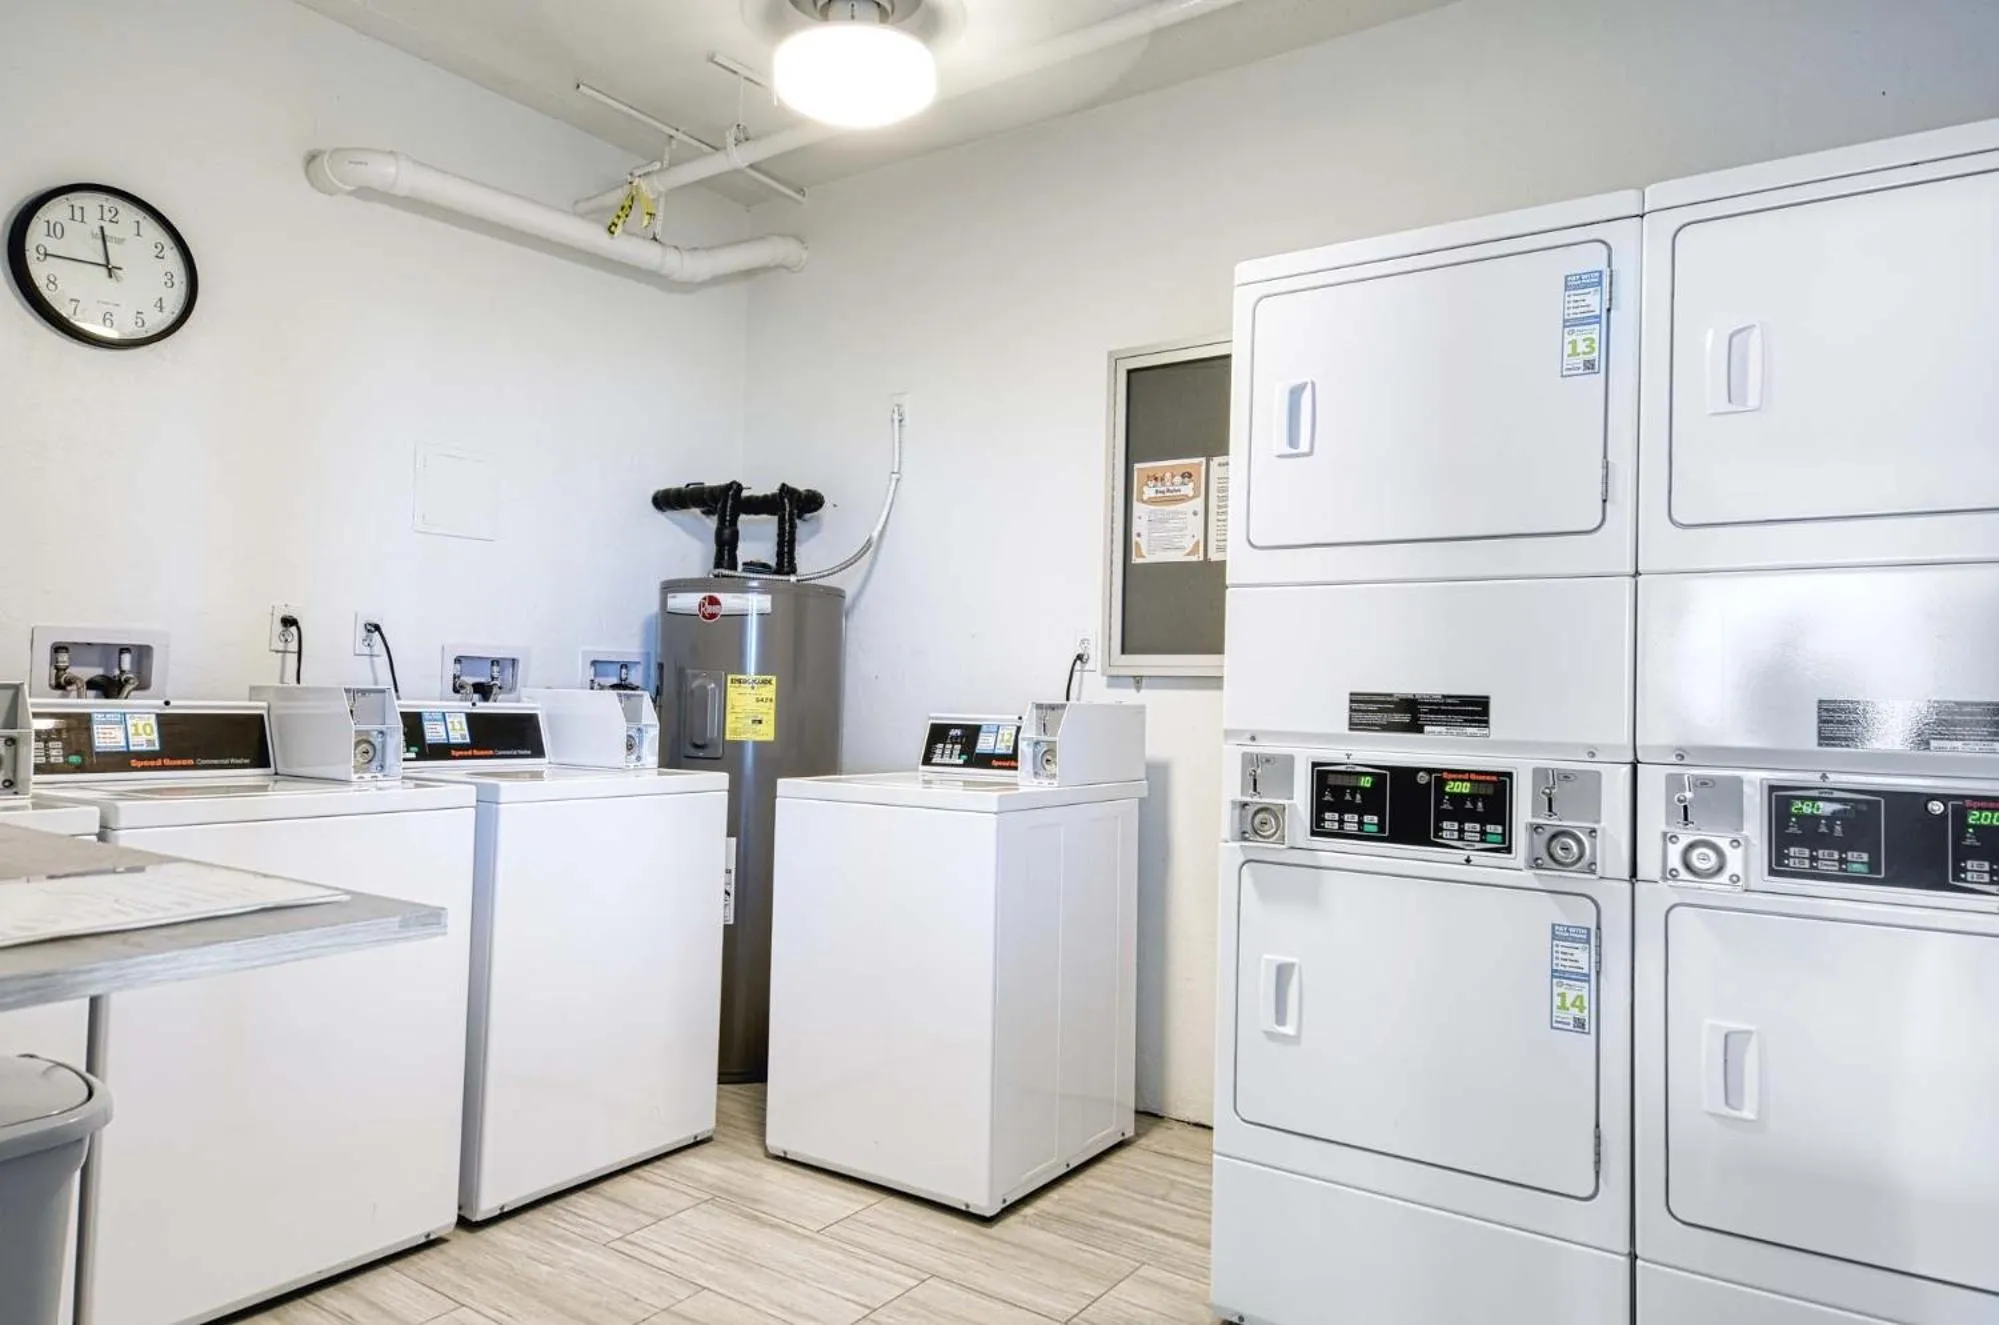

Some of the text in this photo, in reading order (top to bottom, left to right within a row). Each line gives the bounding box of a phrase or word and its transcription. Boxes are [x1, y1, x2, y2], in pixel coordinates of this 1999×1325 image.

[68, 204, 86, 224] 11
[98, 204, 120, 224] 12
[44, 220, 64, 240] 10
[134, 220, 142, 237] 1
[36, 244, 48, 262] 9
[154, 242, 166, 260] 2
[46, 273, 58, 292] 8
[164, 271, 174, 288] 3
[68, 298, 80, 316] 7
[153, 296, 164, 312] 4
[102, 312, 114, 329] 6
[134, 312, 146, 328] 5
[1567, 336, 1596, 358] 13
[131, 722, 154, 737] 10
[450, 720, 464, 732] 11
[451, 748, 472, 757] Speed
[130, 759, 162, 768] Speed
[164, 758, 194, 766] Queen
[992, 759, 1010, 767] Speed
[1360, 776, 1372, 788] 10
[1442, 772, 1498, 782] Speed Queen
[1444, 781, 1470, 793] 2.00
[1556, 991, 1586, 1014] 14
